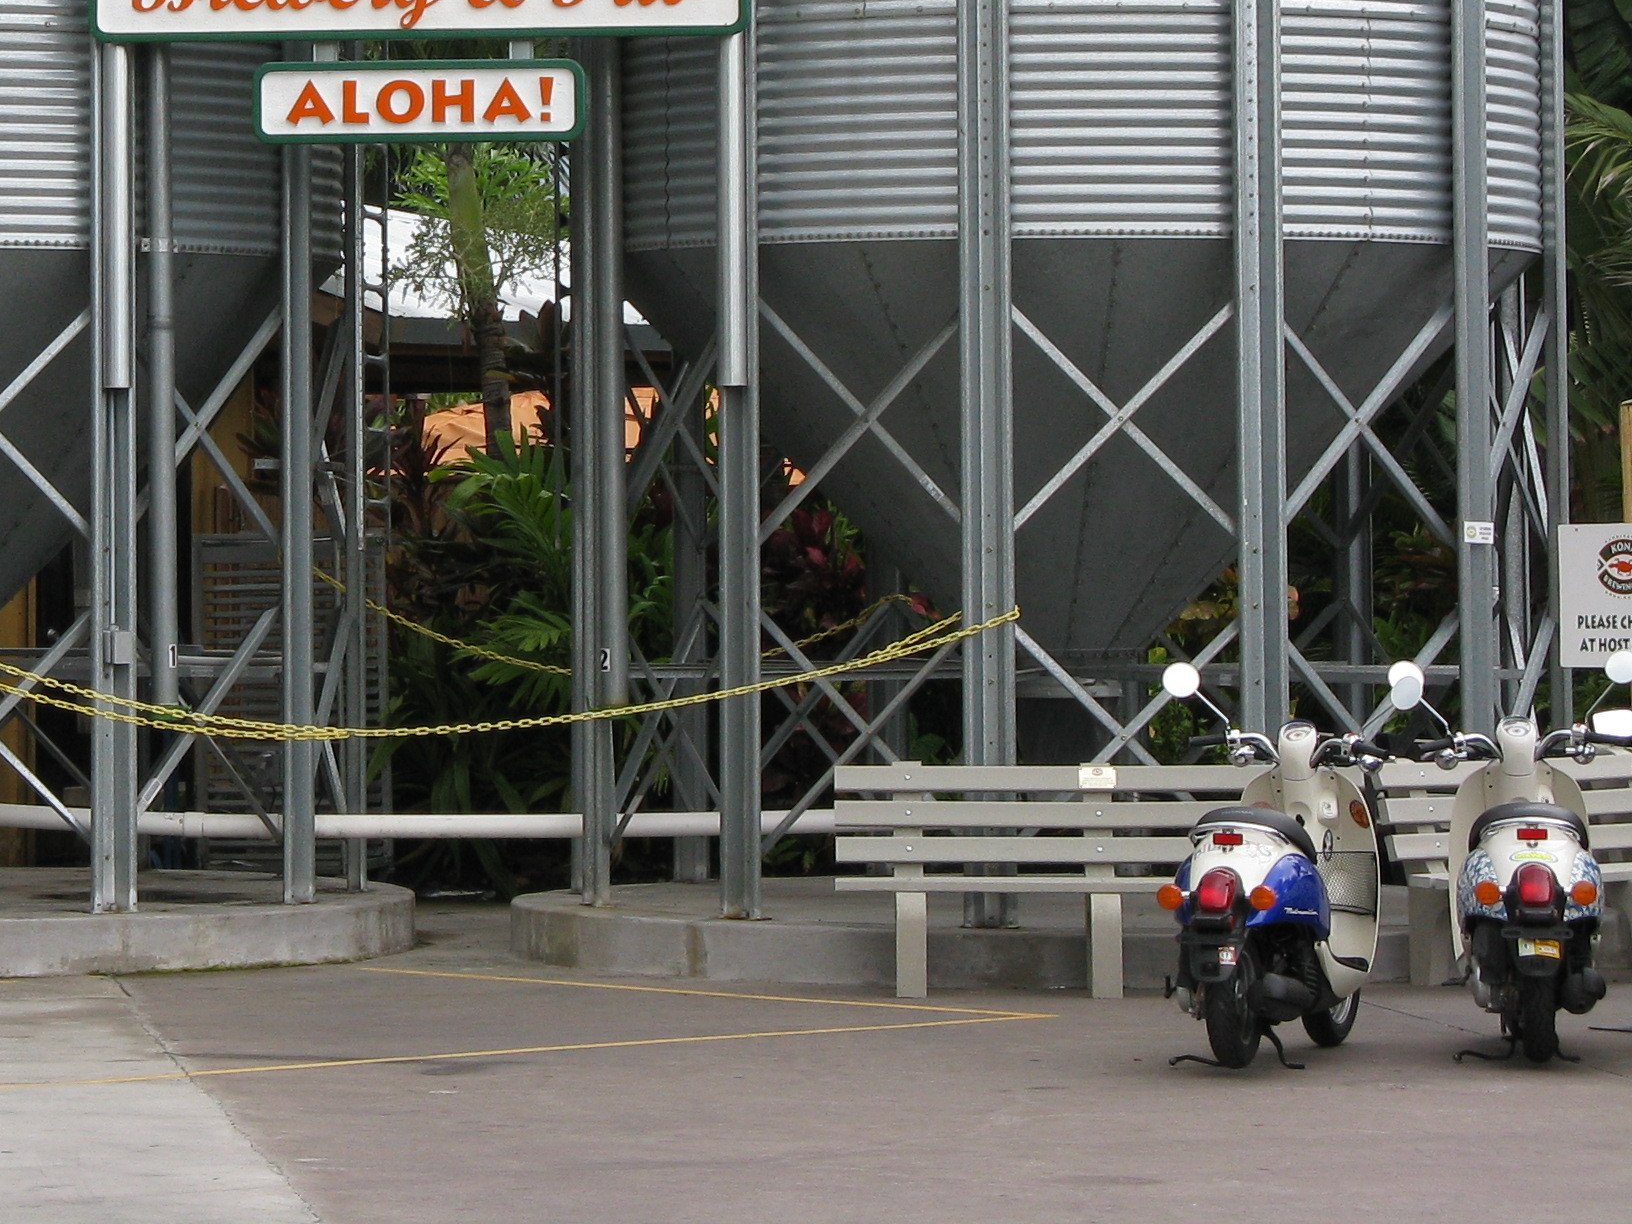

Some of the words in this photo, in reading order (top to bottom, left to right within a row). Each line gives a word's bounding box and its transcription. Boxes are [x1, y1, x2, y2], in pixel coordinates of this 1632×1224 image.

[285, 76, 555, 126] ALOHA!
[1610, 541, 1632, 554] KON
[1577, 614, 1618, 629] PLEASE
[1579, 637, 1596, 652] AT
[1599, 637, 1630, 652] HOST
[169, 645, 176, 667] 1
[600, 649, 608, 671] 2
